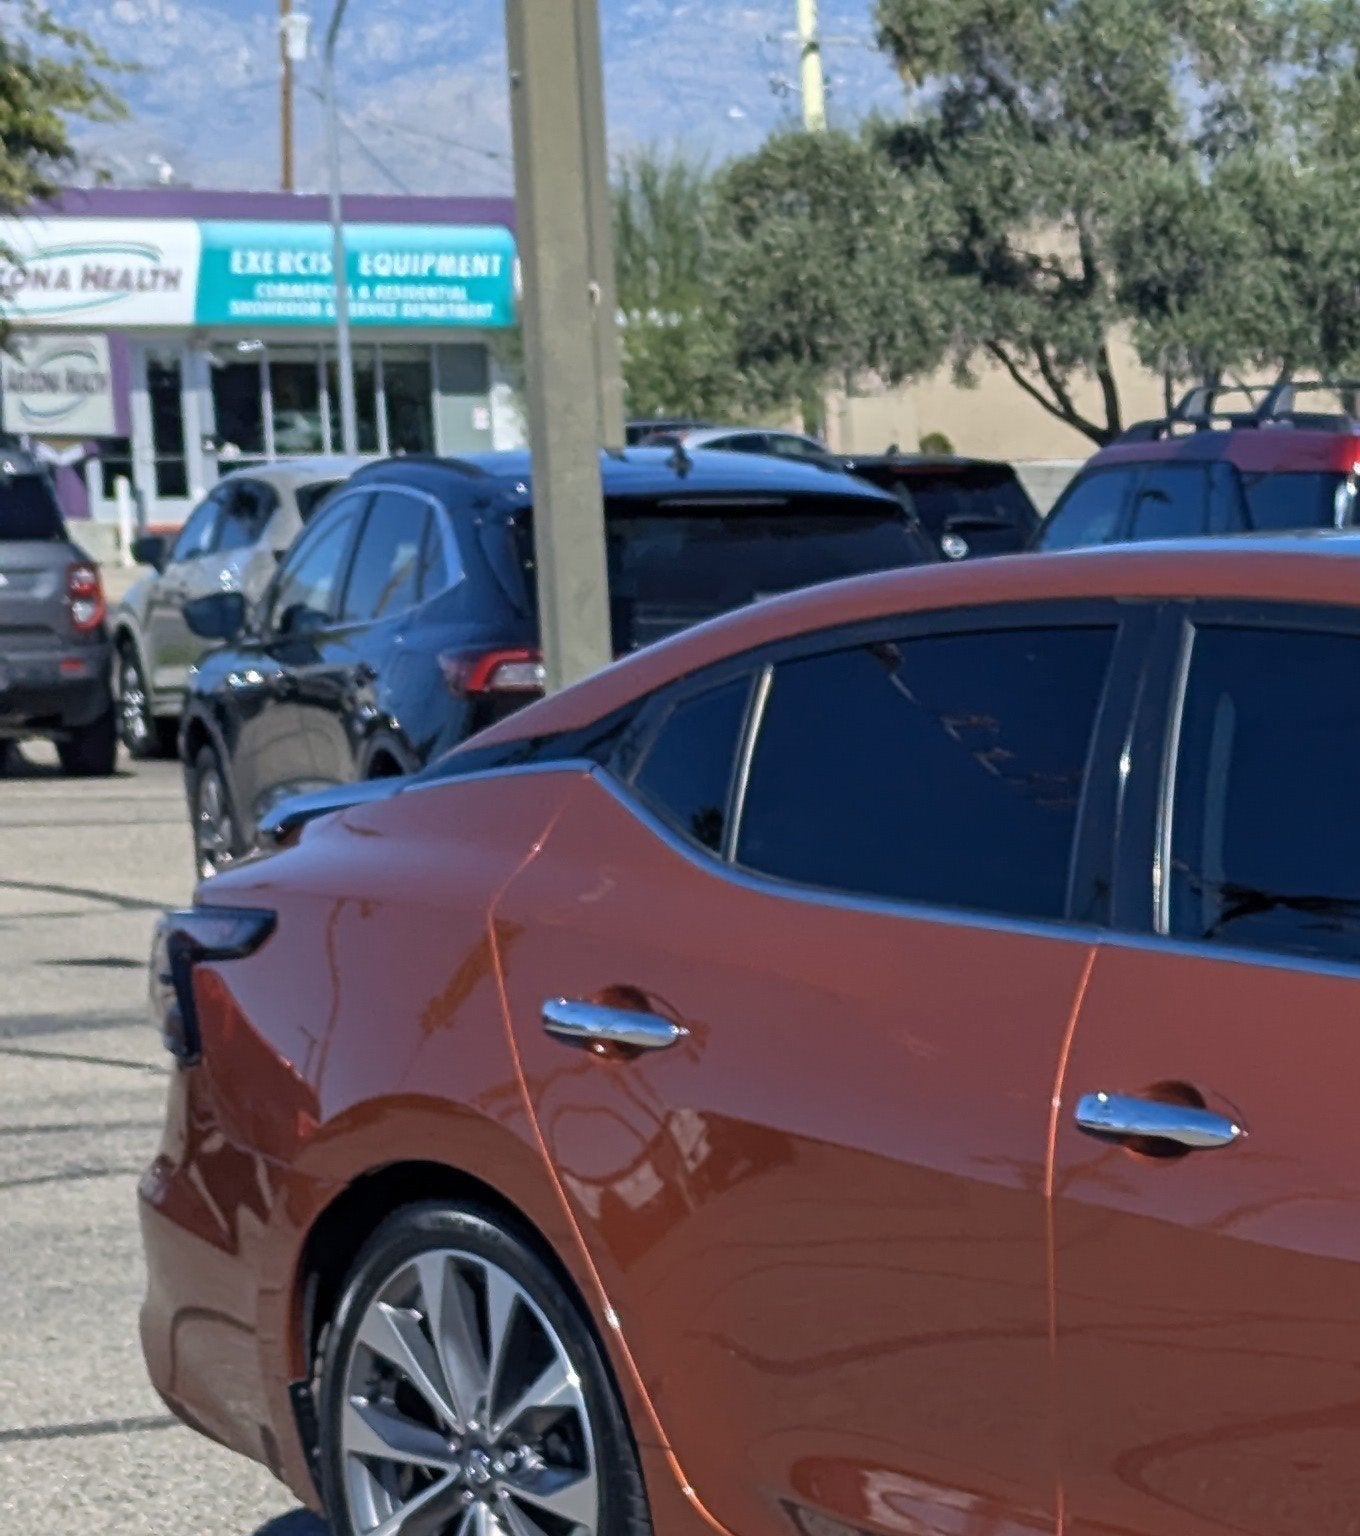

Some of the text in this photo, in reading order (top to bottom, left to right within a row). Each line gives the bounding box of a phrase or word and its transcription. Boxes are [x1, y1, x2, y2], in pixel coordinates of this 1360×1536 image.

[81, 264, 182, 292] HEALTH
[229, 250, 502, 278] EXERCIS EQUIPMENT
